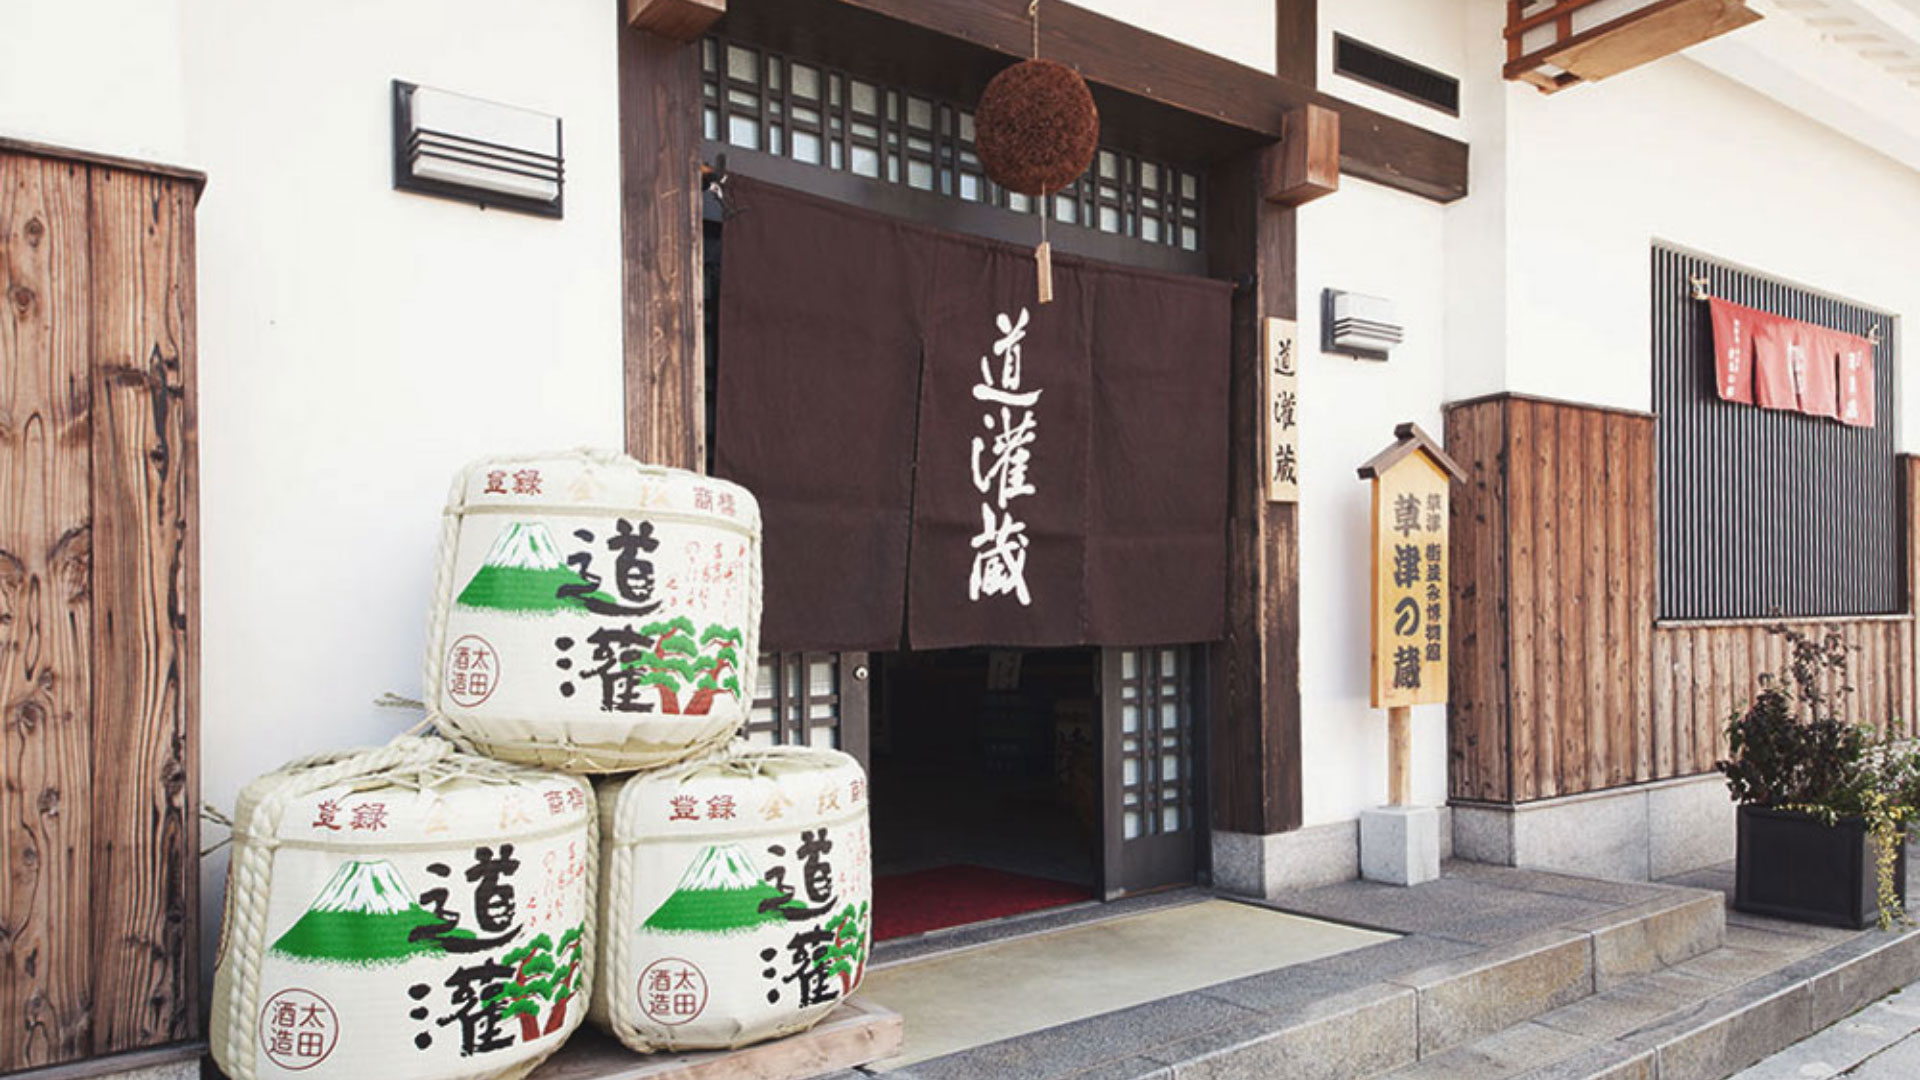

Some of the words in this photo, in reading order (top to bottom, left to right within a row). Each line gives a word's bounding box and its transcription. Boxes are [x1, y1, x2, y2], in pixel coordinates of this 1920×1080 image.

[1273, 338, 1297, 485] 道灌蔵
[483, 468, 544, 496] 登録
[969, 306, 1043, 605] 道灌蔵
[555, 517, 663, 713] 道灌
[1393, 492, 1421, 690] 草津の蔵
[451, 646, 470, 698] 酒造
[470, 649, 491, 698] 太田
[311, 799, 390, 832] 登録
[668, 793, 737, 822] 登録
[757, 827, 839, 1009] 道灌
[408, 843, 529, 1058] 道灌
[649, 968, 672, 1017] 酒造
[673, 968, 697, 1016] 太田
[269, 1000, 297, 1057] 酒造
[298, 1002, 326, 1058] 太田
